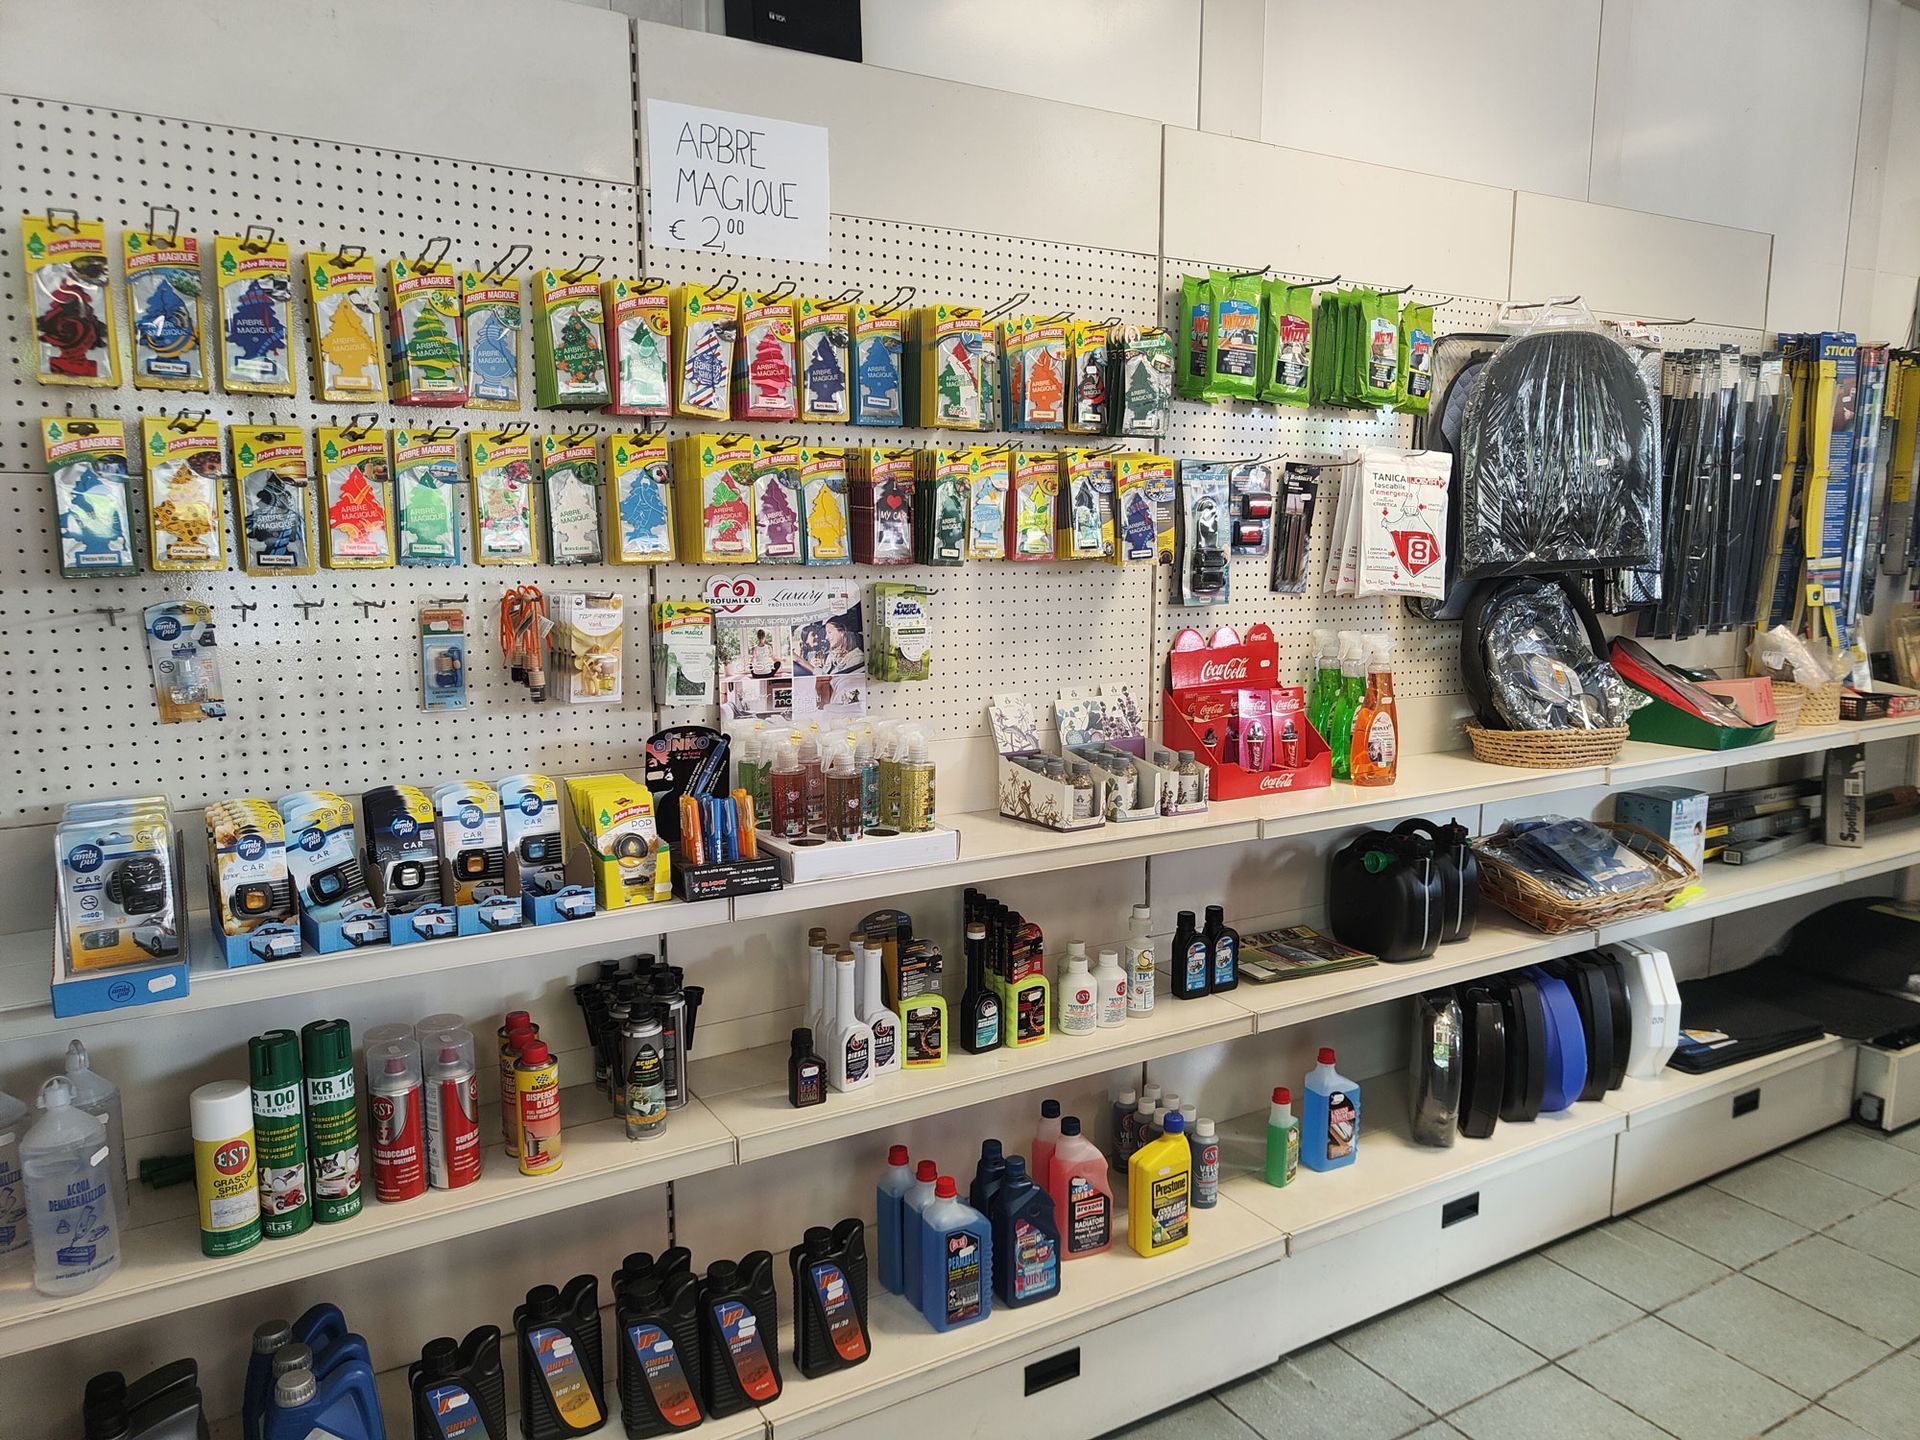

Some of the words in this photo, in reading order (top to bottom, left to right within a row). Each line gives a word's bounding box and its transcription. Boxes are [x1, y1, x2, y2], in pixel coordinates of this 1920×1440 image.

[677, 122, 766, 169] ARBRE
[677, 168, 798, 219] MAGIQUE
[669, 220, 685, 240] €
[129, 254, 154, 267] ARBRE
[156, 252, 198, 263] MAGIQUE
[331, 276, 345, 284] Arbre
[347, 273, 373, 282] Magique
[398, 281, 419, 292] ARBRE
[420, 278, 453, 287] MAGIQUE
[466, 293, 487, 302] ARBRE
[488, 290, 518, 299] MAGIQUE
[548, 291, 569, 301] ARBRE
[571, 285, 598, 295] MAGIQUE
[618, 300, 637, 311] ARBRE
[639, 296, 667, 306] MAGIQUE
[745, 310, 763, 320] ARBRE
[764, 307, 790, 317] MAGIQUE
[802, 317, 818, 326] ARBRE
[819, 314, 845, 322] MAGIQUE
[858, 324, 874, 333] ARBRE
[875, 320, 898, 328] MAGIQUE
[1824, 346, 1857, 356] STICKY
[169, 441, 188, 451] Arbre
[190, 438, 217, 447] Magique
[341, 448, 357, 457] Arbre
[358, 444, 383, 453] Magique
[257, 450, 275, 461] Arbre
[276, 446, 302, 456] Magique
[398, 449, 420, 460] ARBRE
[421, 445, 454, 455] MAGIQUE
[490, 451, 506, 460] Arbre
[507, 448, 528, 456] Magique
[546, 454, 565, 464] ARBRE
[566, 449, 594, 459] MAGIQUE
[630, 452, 644, 461] Arbre
[645, 449, 665, 458] Magique
[716, 453, 729, 462] Arbre
[730, 450, 750, 459] Magique
[1017, 468, 1033, 477] ARBRE
[1034, 464, 1057, 473] MAGIQUE
[1125, 474, 1142, 482] ARBRE
[1143, 469, 1166, 477] MAGIQUE
[1373, 473, 1407, 482] TANICA
[1375, 482, 1405, 490] tascabile
[1411, 541, 1427, 560] 8
[768, 589, 824, 603] Luxury
[155, 621, 176, 631] ambi
[739, 617, 765, 625] quality
[767, 617, 790, 625] spray
[162, 628, 176, 637] pur
[1250, 633, 1267, 641] Coca-Cola
[172, 642, 194, 650] CAR
[1201, 657, 1248, 682] Coca-Cola
[1200, 704, 1223, 715] Coca-Cola
[1276, 698, 1300, 711] Coca-Cola
[1260, 773, 1295, 790] Coca-Cola
[520, 799, 540, 809] ambi
[526, 804, 539, 814] pur
[459, 811, 480, 821] ambi
[613, 811, 627, 821] Arbre
[627, 806, 650, 815] Magique
[394, 821, 414, 831] ambi
[466, 817, 479, 825] pur
[631, 819, 652, 828] POP
[400, 826, 414, 835] pur
[463, 831, 482, 839] CAR
[239, 839, 261, 850] ambi
[301, 833, 321, 844] ambi
[307, 839, 321, 848] pur
[403, 841, 424, 849] CAR
[72, 848, 98, 861] ambi
[246, 846, 260, 855] pur
[309, 850, 330, 863] CAR
[79, 857, 97, 868] pur
[241, 862, 265, 871] CAR
[75, 875, 101, 884] CAR
[848, 1050, 868, 1062] DIESEL
[312, 1078, 334, 1095] KR
[800, 1084, 817, 1093] USA
[264, 1090, 294, 1107] 100
[373, 1103, 392, 1117] EST
[216, 1145, 249, 1168] EST
[213, 1171, 253, 1188] GRASSO
[67, 1178, 90, 1195] ACQUA
[218, 1181, 249, 1195] SPRAY
[1155, 1178, 1186, 1197] Prestone
[1076, 1202, 1103, 1213] arexons
[1075, 1216, 1104, 1229] RADIATORI
[644, 1355, 674, 1369] SINTIAX
[555, 1383, 581, 1397] 10W/40
